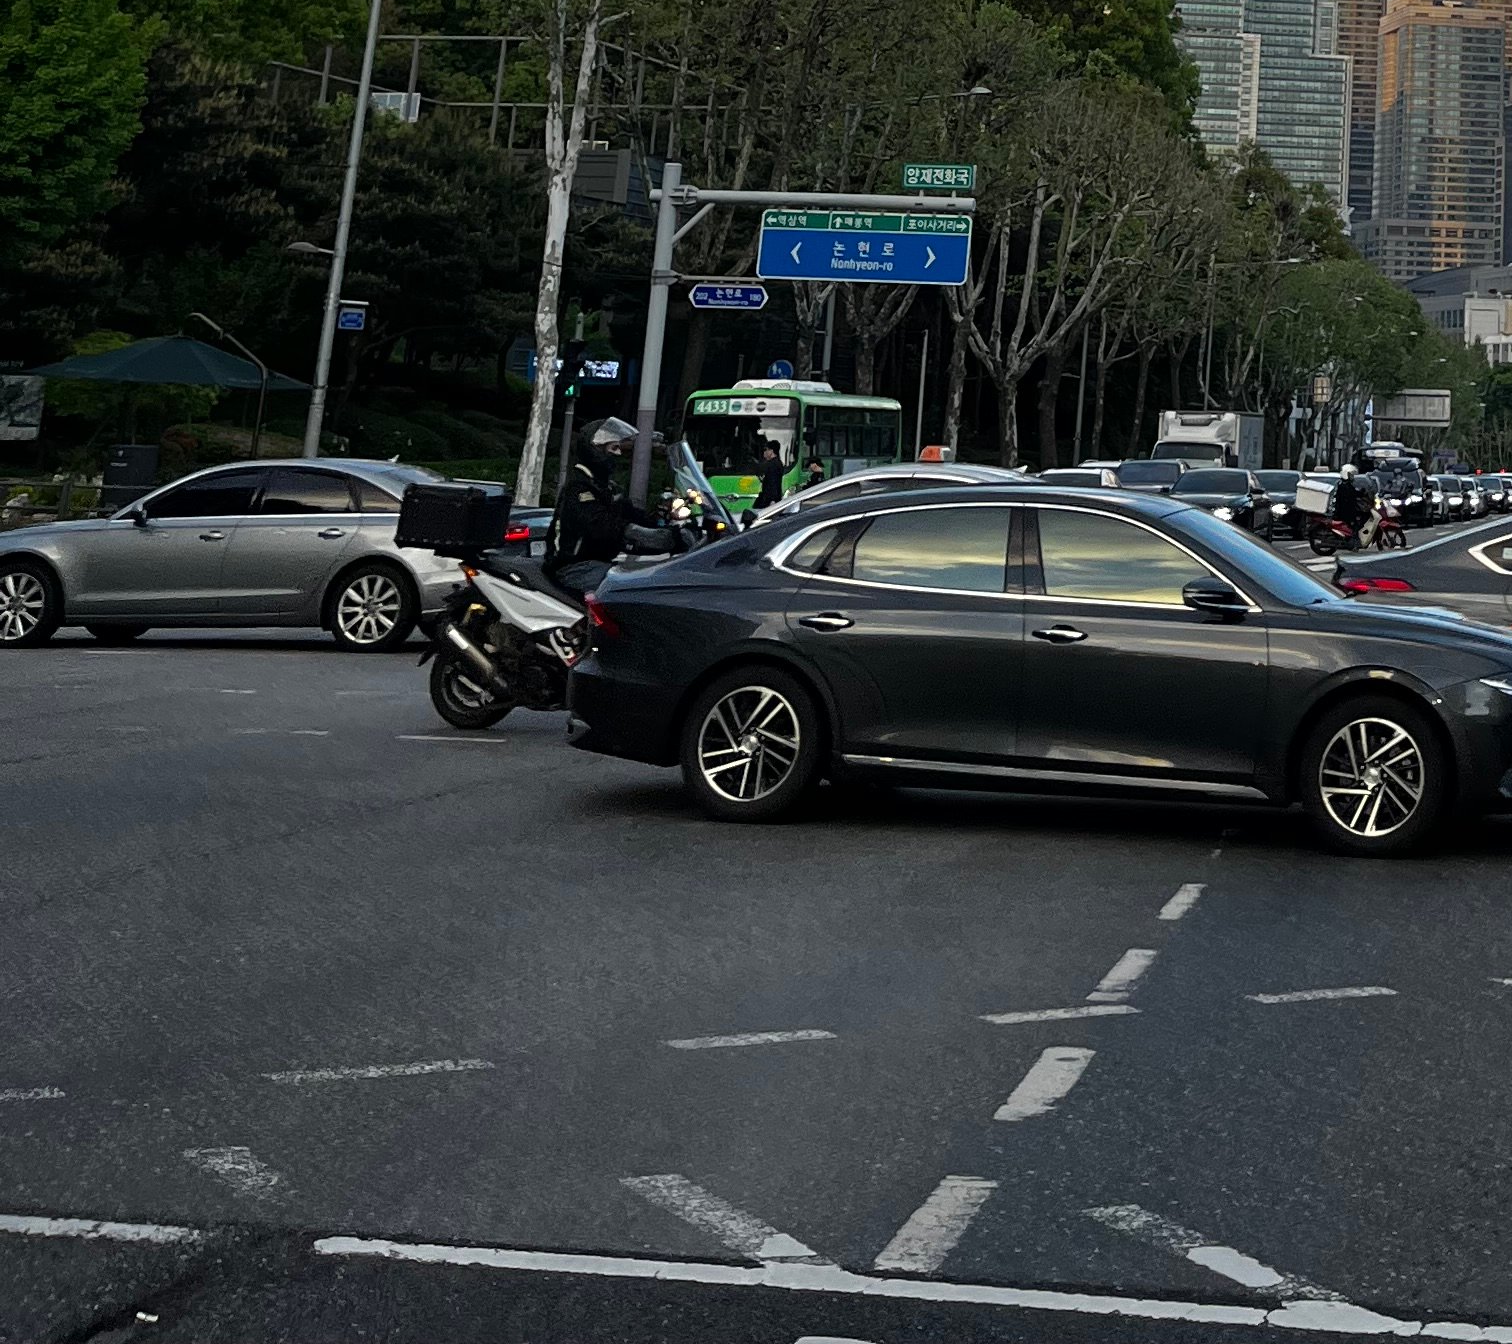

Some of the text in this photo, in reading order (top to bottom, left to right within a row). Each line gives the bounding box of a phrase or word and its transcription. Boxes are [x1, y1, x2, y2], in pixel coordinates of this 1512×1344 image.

[907, 167, 970, 185] 양재전화국
[777, 215, 807, 227] 역삼역
[906, 218, 957, 232] 포이사거리
[697, 400, 728, 413] 4433
